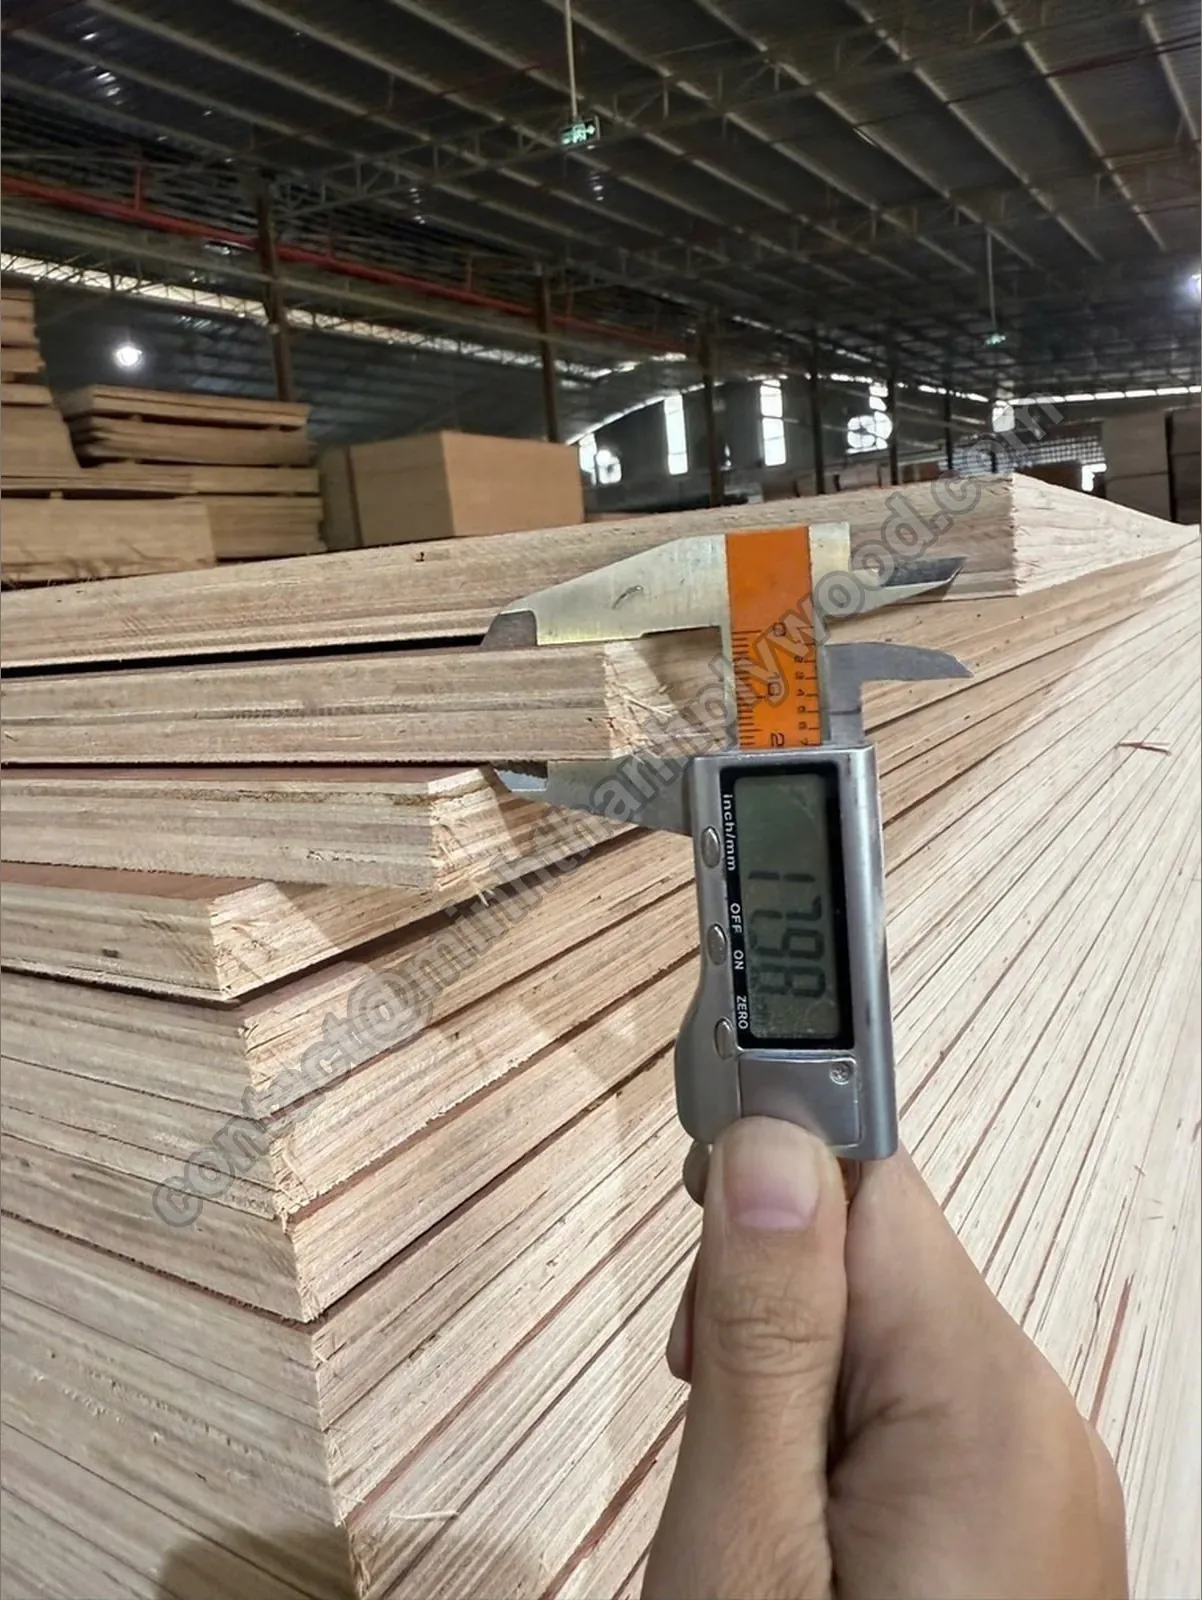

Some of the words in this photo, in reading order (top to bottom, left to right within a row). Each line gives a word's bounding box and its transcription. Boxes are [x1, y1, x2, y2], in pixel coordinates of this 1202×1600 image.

[722, 793, 736, 871] inch/mm
[730, 903, 743, 934] OFF
[733, 950, 745, 971] ON
[736, 995, 749, 1030] ZERO
